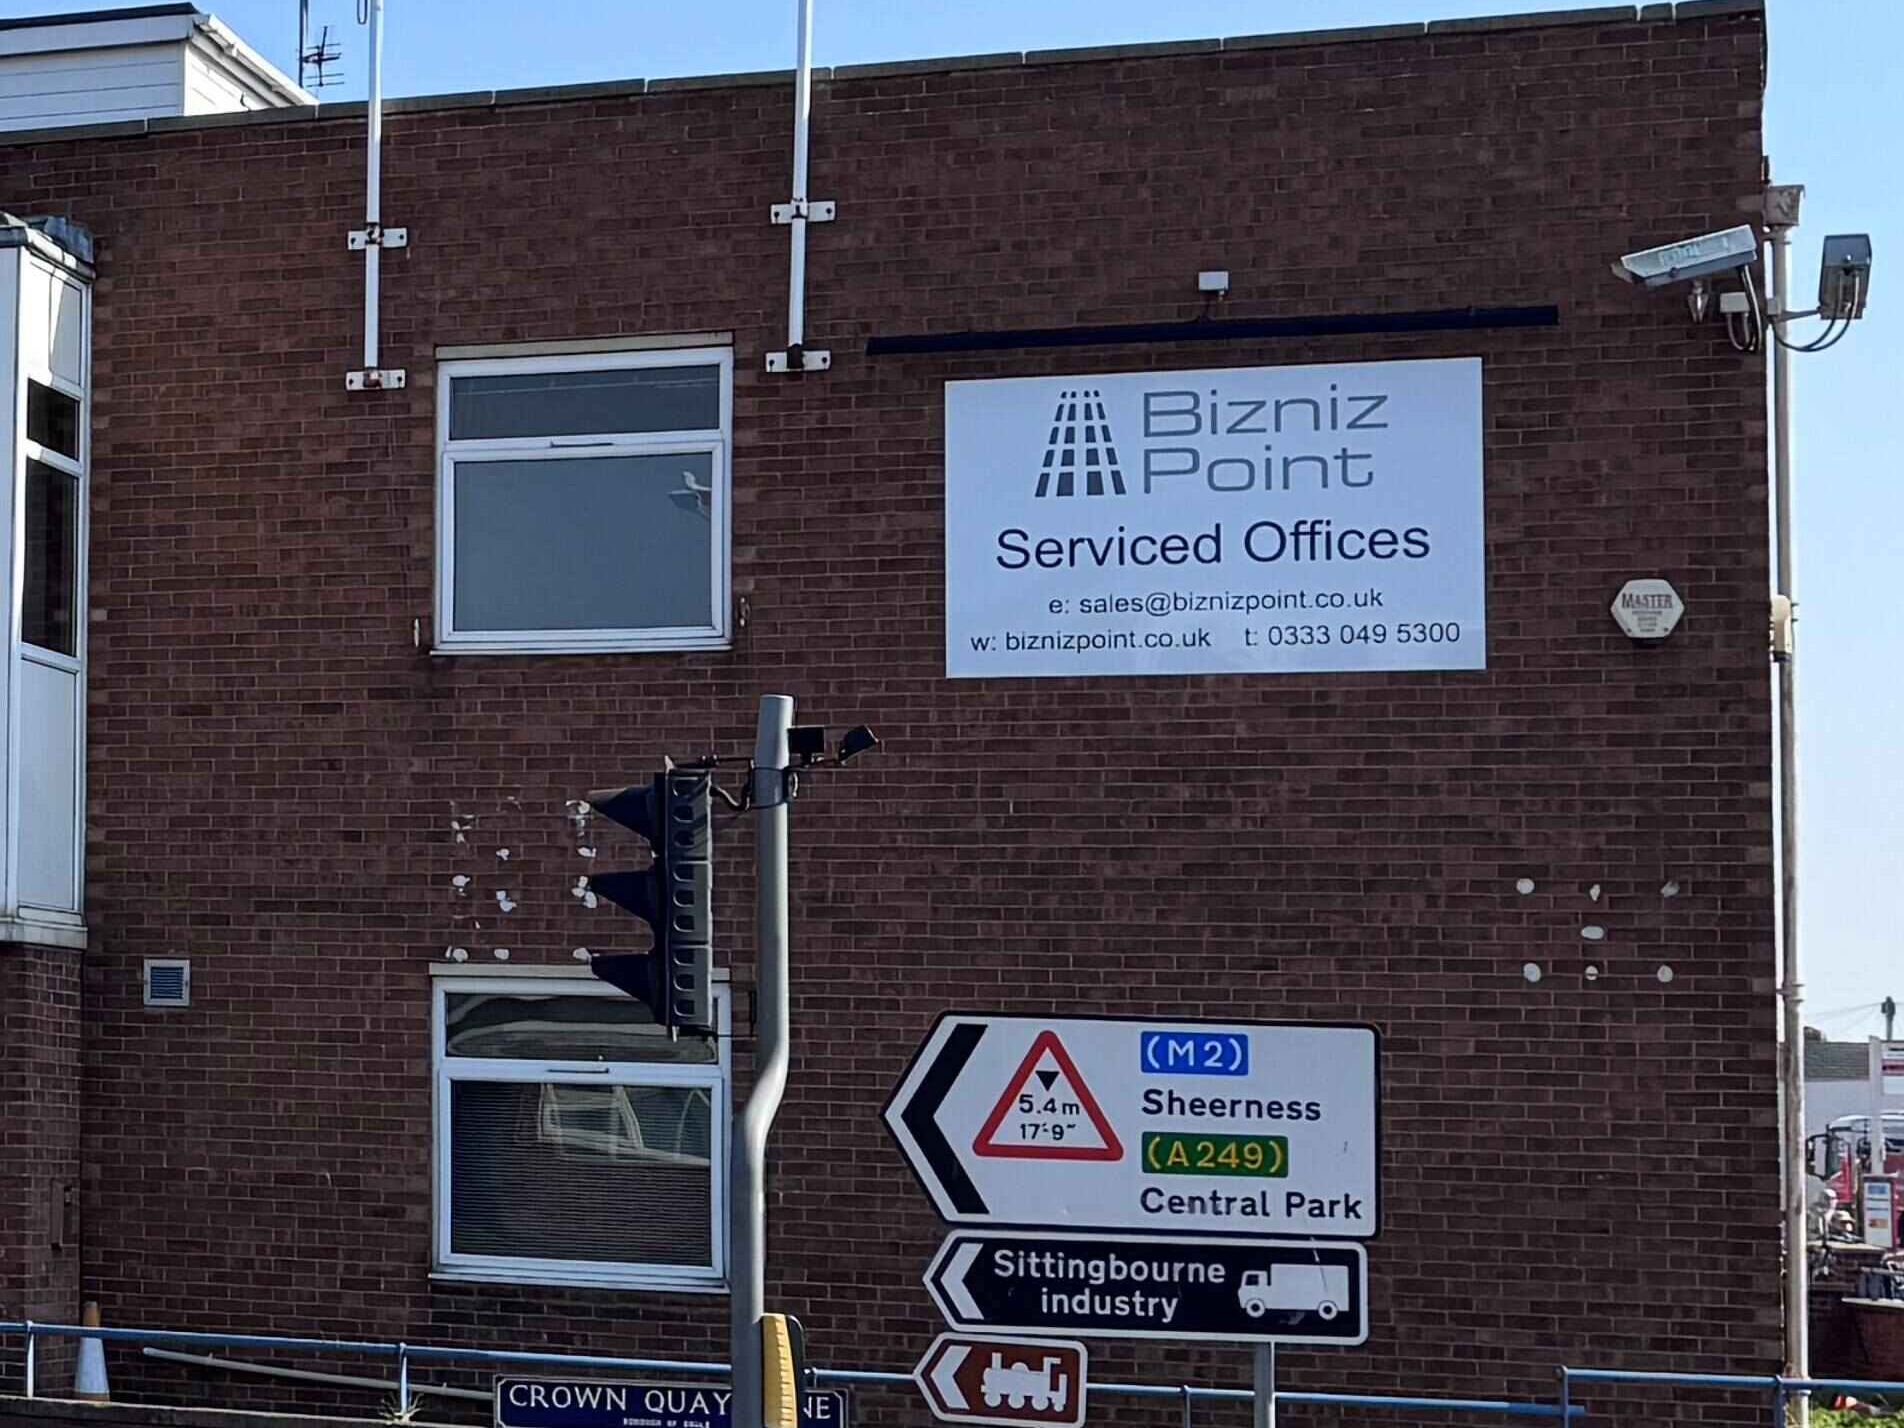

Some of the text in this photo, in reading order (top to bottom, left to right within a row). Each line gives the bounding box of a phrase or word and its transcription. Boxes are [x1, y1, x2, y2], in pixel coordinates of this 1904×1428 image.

[1143, 383, 1389, 438] Bizniz
[1143, 444, 1374, 495] Point
[995, 518, 1431, 569] Serviced Offices
[1049, 587, 1383, 617] e: sales@biznizpoint.co.uk
[970, 621, 1461, 654] w: biznizpoint.co.uk t: 0333 049 5300
[1146, 1036, 1244, 1069] (M2)
[1141, 1088, 1322, 1123] Sheerness
[1140, 1187, 1362, 1220] Central Park
[993, 1248, 1226, 1285] Sittingbourne
[1041, 1287, 1179, 1323] industry
[509, 1384, 627, 1412] CROWN
[644, 1389, 732, 1417] QUAY
